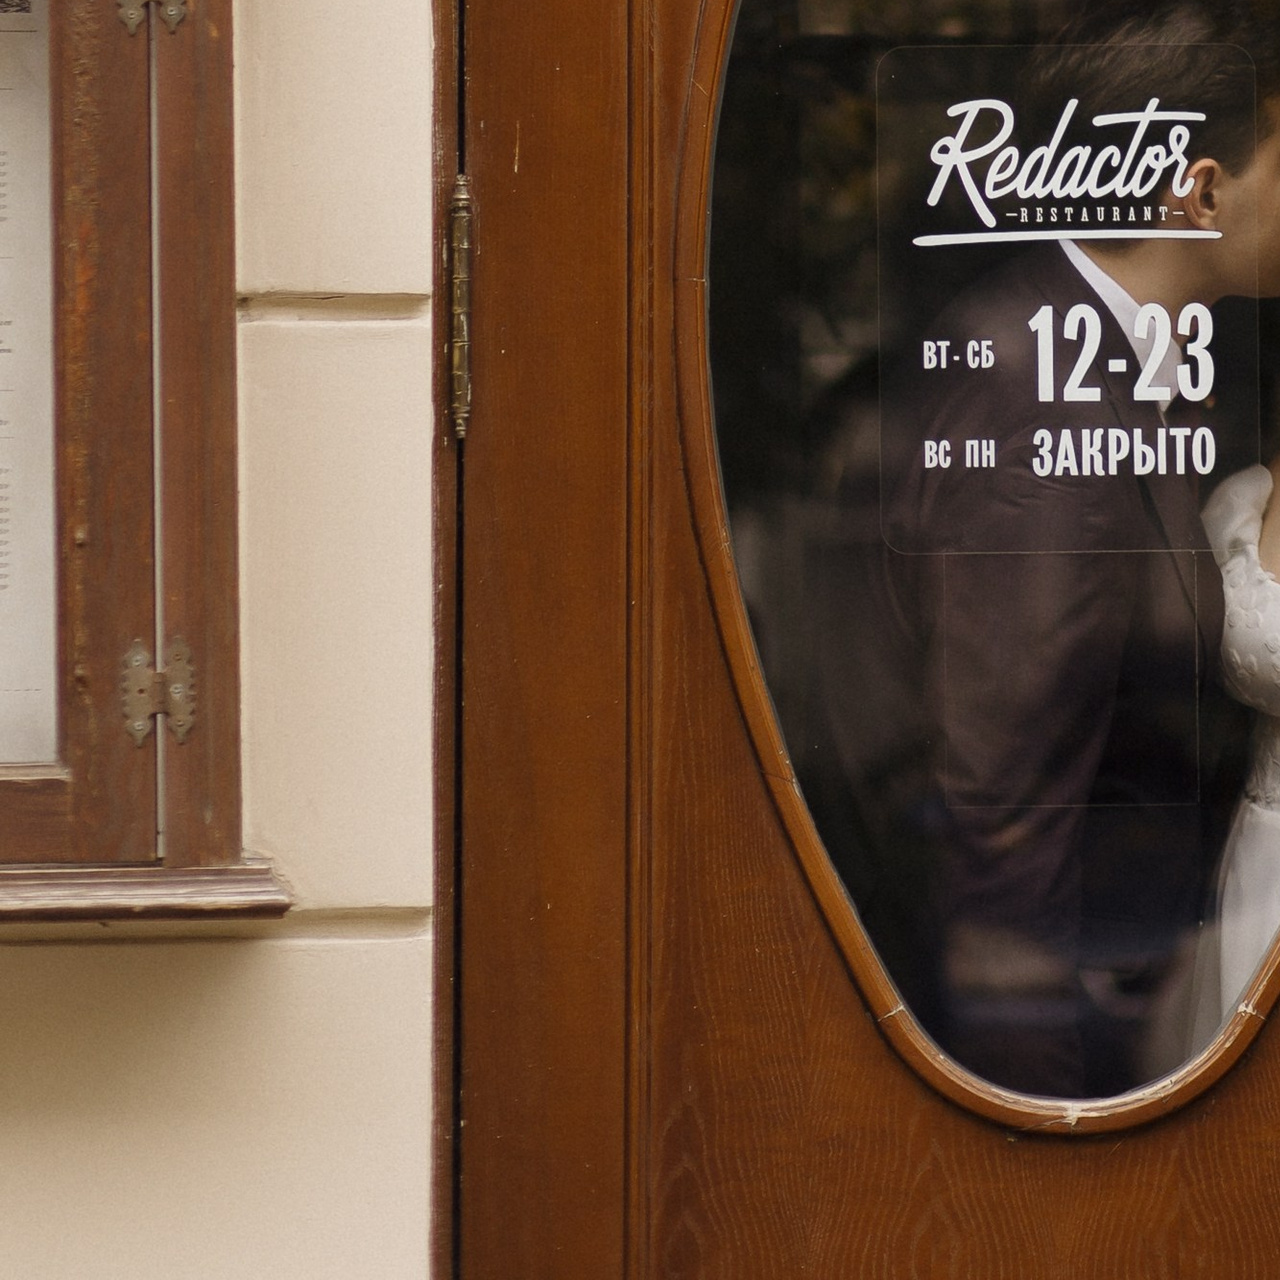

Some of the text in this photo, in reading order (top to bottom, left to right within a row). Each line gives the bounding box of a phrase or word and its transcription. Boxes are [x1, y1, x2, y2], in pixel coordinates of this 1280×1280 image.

[927, 97, 1206, 228] Redactor
[1019, 206, 1168, 223] RESTAURANT
[1027, 302, 1215, 403] 12-23
[924, 439, 996, 469] ВС ПН
[1032, 426, 1216, 477] ЗАКРЫТО
